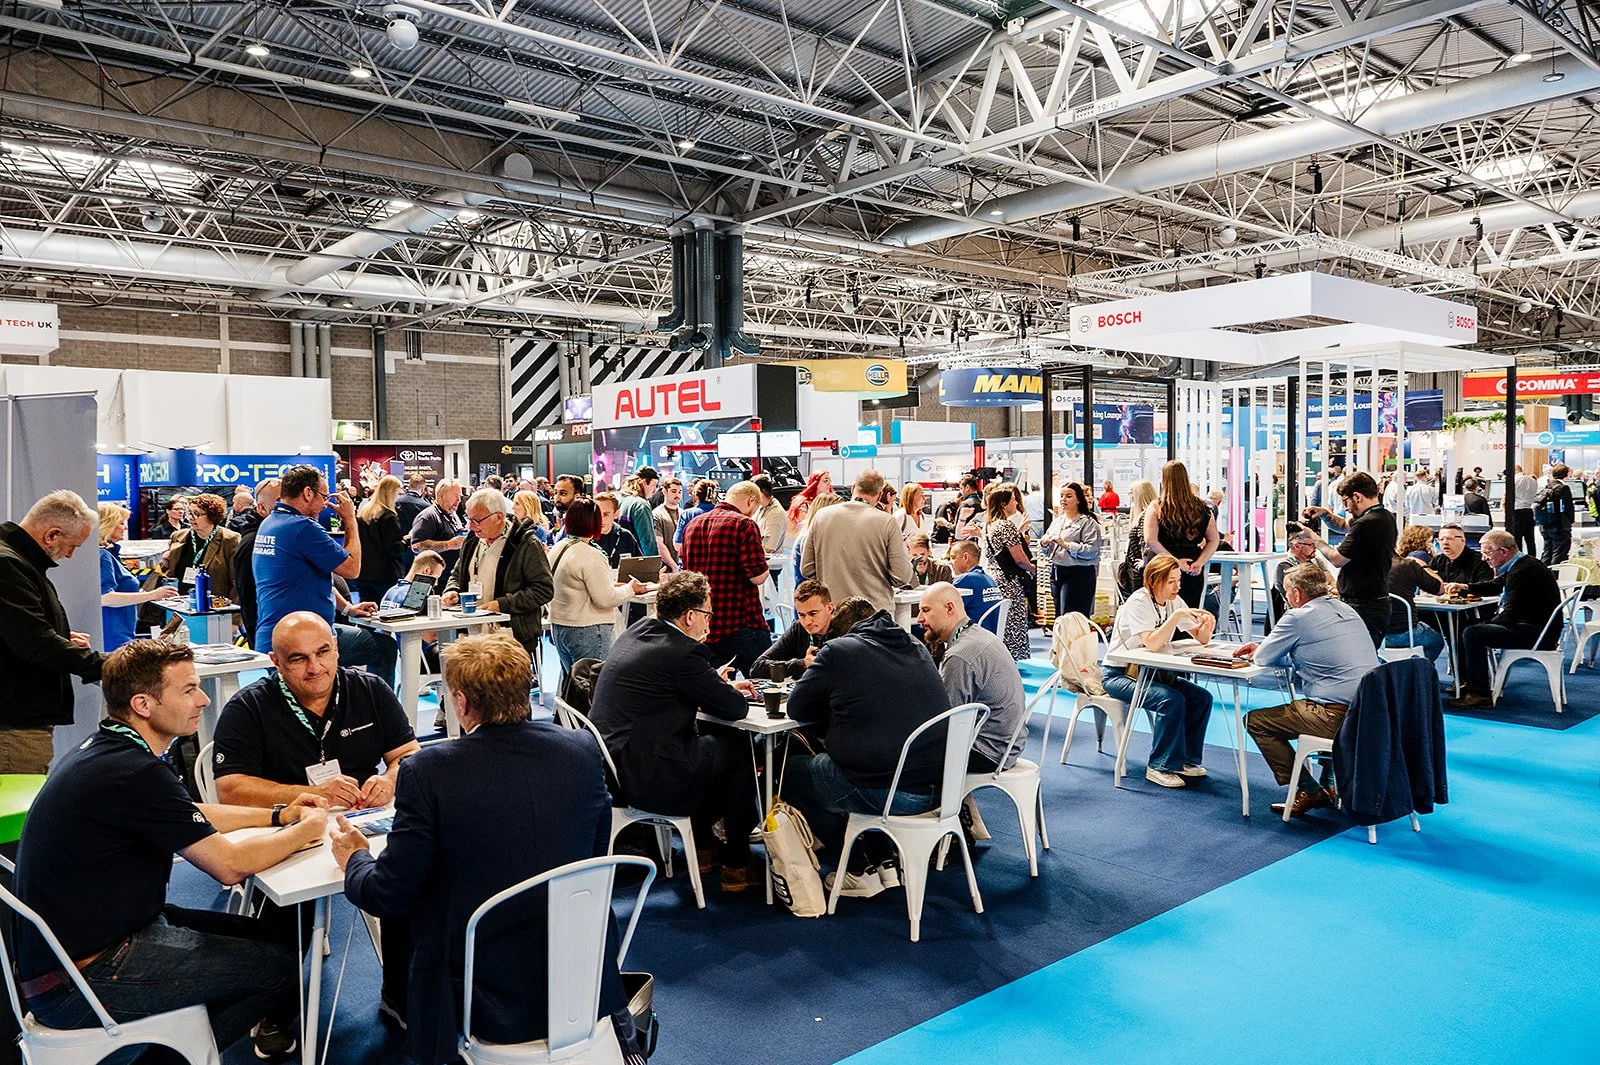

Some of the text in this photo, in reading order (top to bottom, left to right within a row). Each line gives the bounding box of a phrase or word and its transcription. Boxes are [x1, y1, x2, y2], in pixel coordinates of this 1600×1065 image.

[6, 319, 34, 327] TECH
[1098, 311, 1142, 328] BOSCH
[1456, 315, 1475, 330] BOSCH
[867, 371, 889, 380] HELLA
[1516, 378, 1576, 391] COMMA
[615, 379, 721, 420] AUTEL
[140, 461, 169, 483] PRO-TECH
